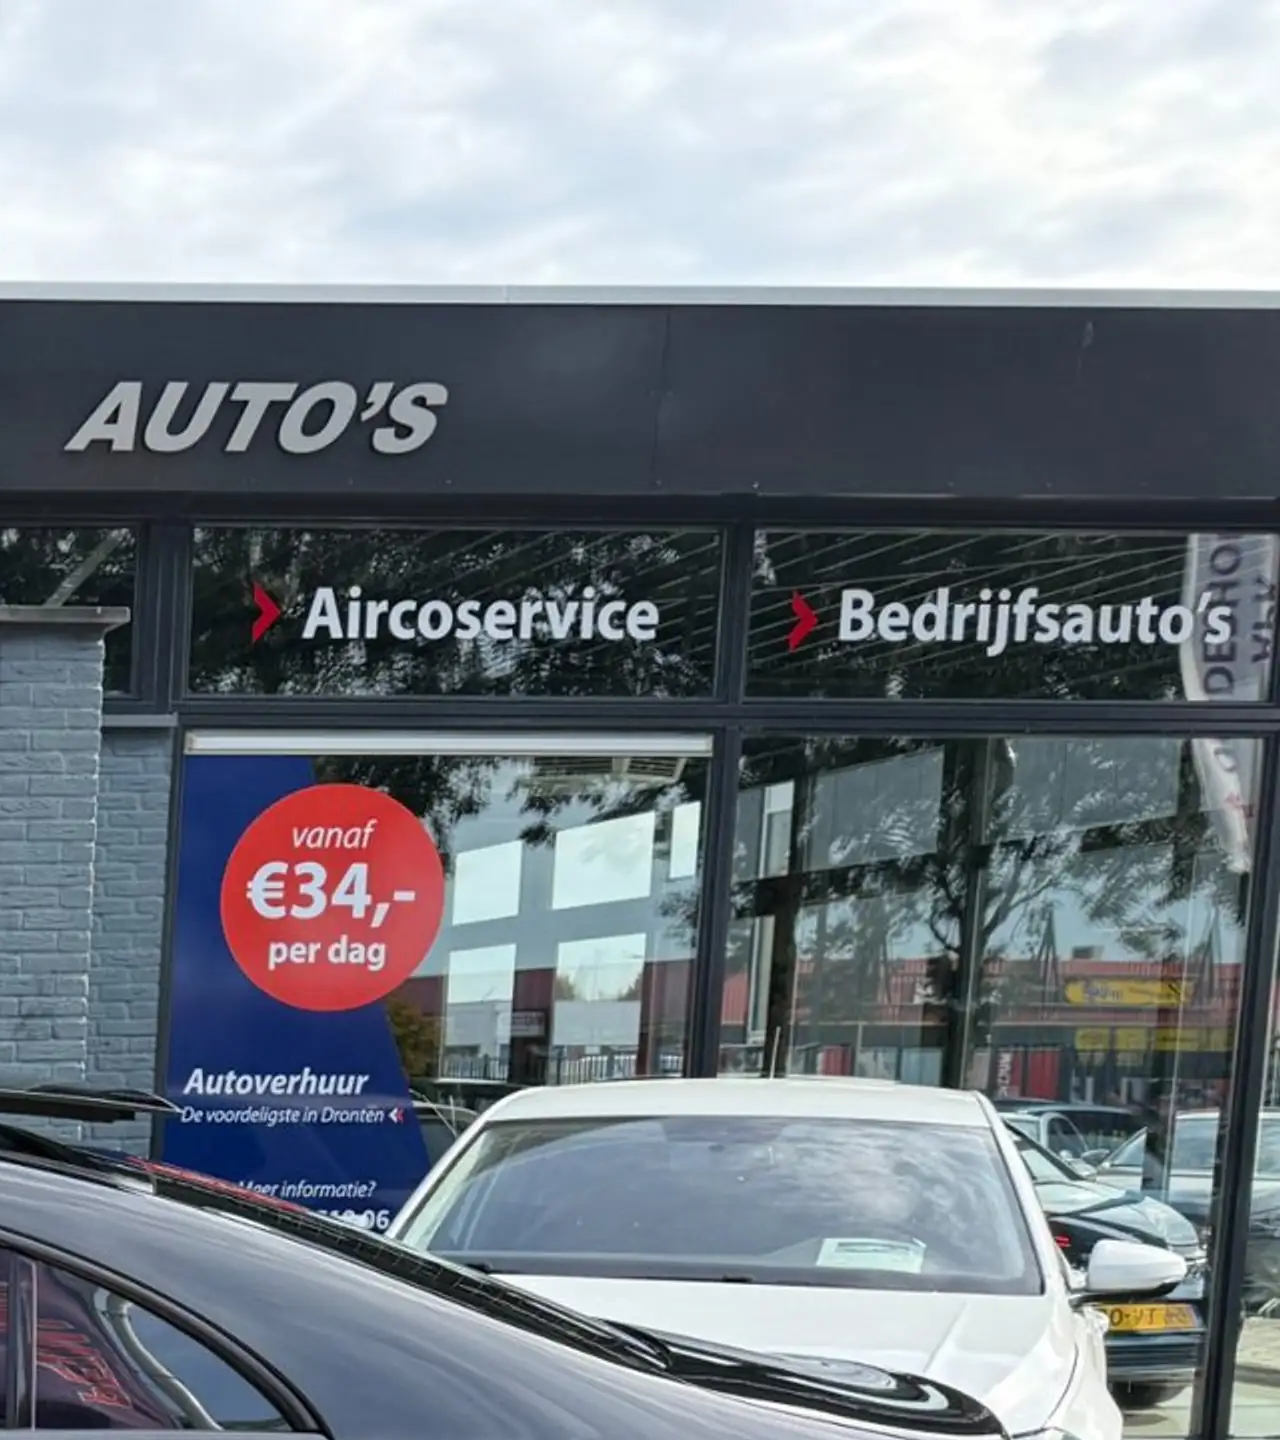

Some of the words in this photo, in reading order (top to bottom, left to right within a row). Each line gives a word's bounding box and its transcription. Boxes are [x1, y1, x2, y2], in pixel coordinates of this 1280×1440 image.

[64, 382, 449, 457] AUTO'S
[302, 586, 660, 643] Aircoservice
[839, 586, 1232, 657] Bedrijfsauto's
[292, 819, 378, 850] vanaf
[246, 861, 417, 928] €34,-
[267, 941, 321, 970] per
[327, 934, 387, 972] dag
[183, 1067, 370, 1096] Autoverhuur
[181, 1107, 203, 1123] De
[206, 1105, 300, 1128] voordeligste
[302, 1106, 318, 1123] in
[320, 1106, 385, 1123] Dronten
[281, 1179, 377, 1199] informatie?
